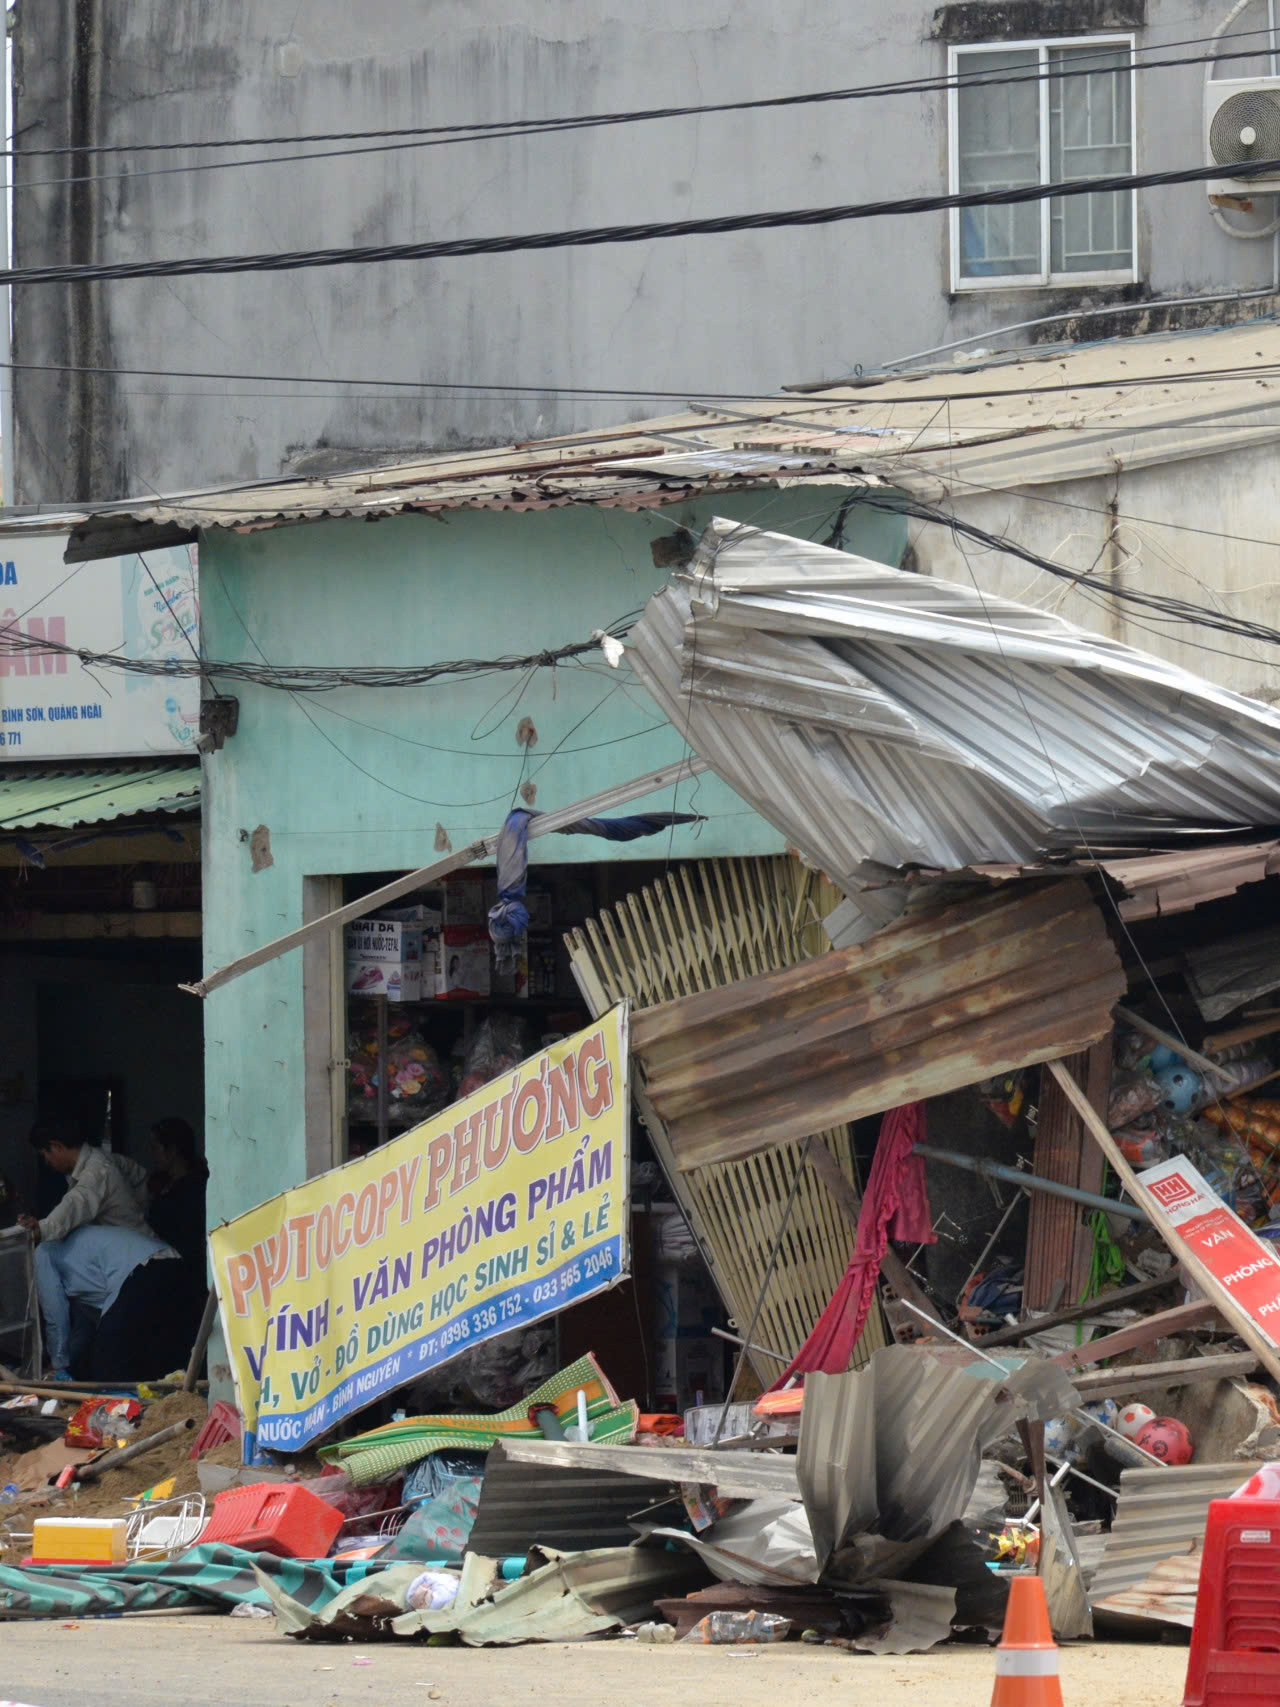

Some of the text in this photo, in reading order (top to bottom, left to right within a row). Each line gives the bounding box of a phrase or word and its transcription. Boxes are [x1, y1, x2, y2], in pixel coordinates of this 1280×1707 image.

[424, 1032, 613, 1210] PHƯƠNG
[291, 1355, 321, 1400] VỞ
[335, 1324, 359, 1375] ĐỒ
[367, 1302, 424, 1355] DÙNG
[430, 1273, 468, 1323] HỌC
[474, 1245, 529, 1292] SINH
[561, 1221, 576, 1251] &
[583, 1192, 611, 1239] LẺ
[353, 1252, 412, 1312] VĂN
[421, 1192, 517, 1279] PHÒNG
[528, 1134, 613, 1221] PHẨM
[258, 1417, 301, 1442] NƯỚC
[357, 1356, 401, 1395] NGUYÊN
[441, 1320, 470, 1349] 0398
[473, 1306, 498, 1332] 336
[500, 1293, 522, 1320] 752
[533, 1279, 558, 1303] 033
[560, 1265, 581, 1291] 565
[584, 1246, 613, 1277] 2046
